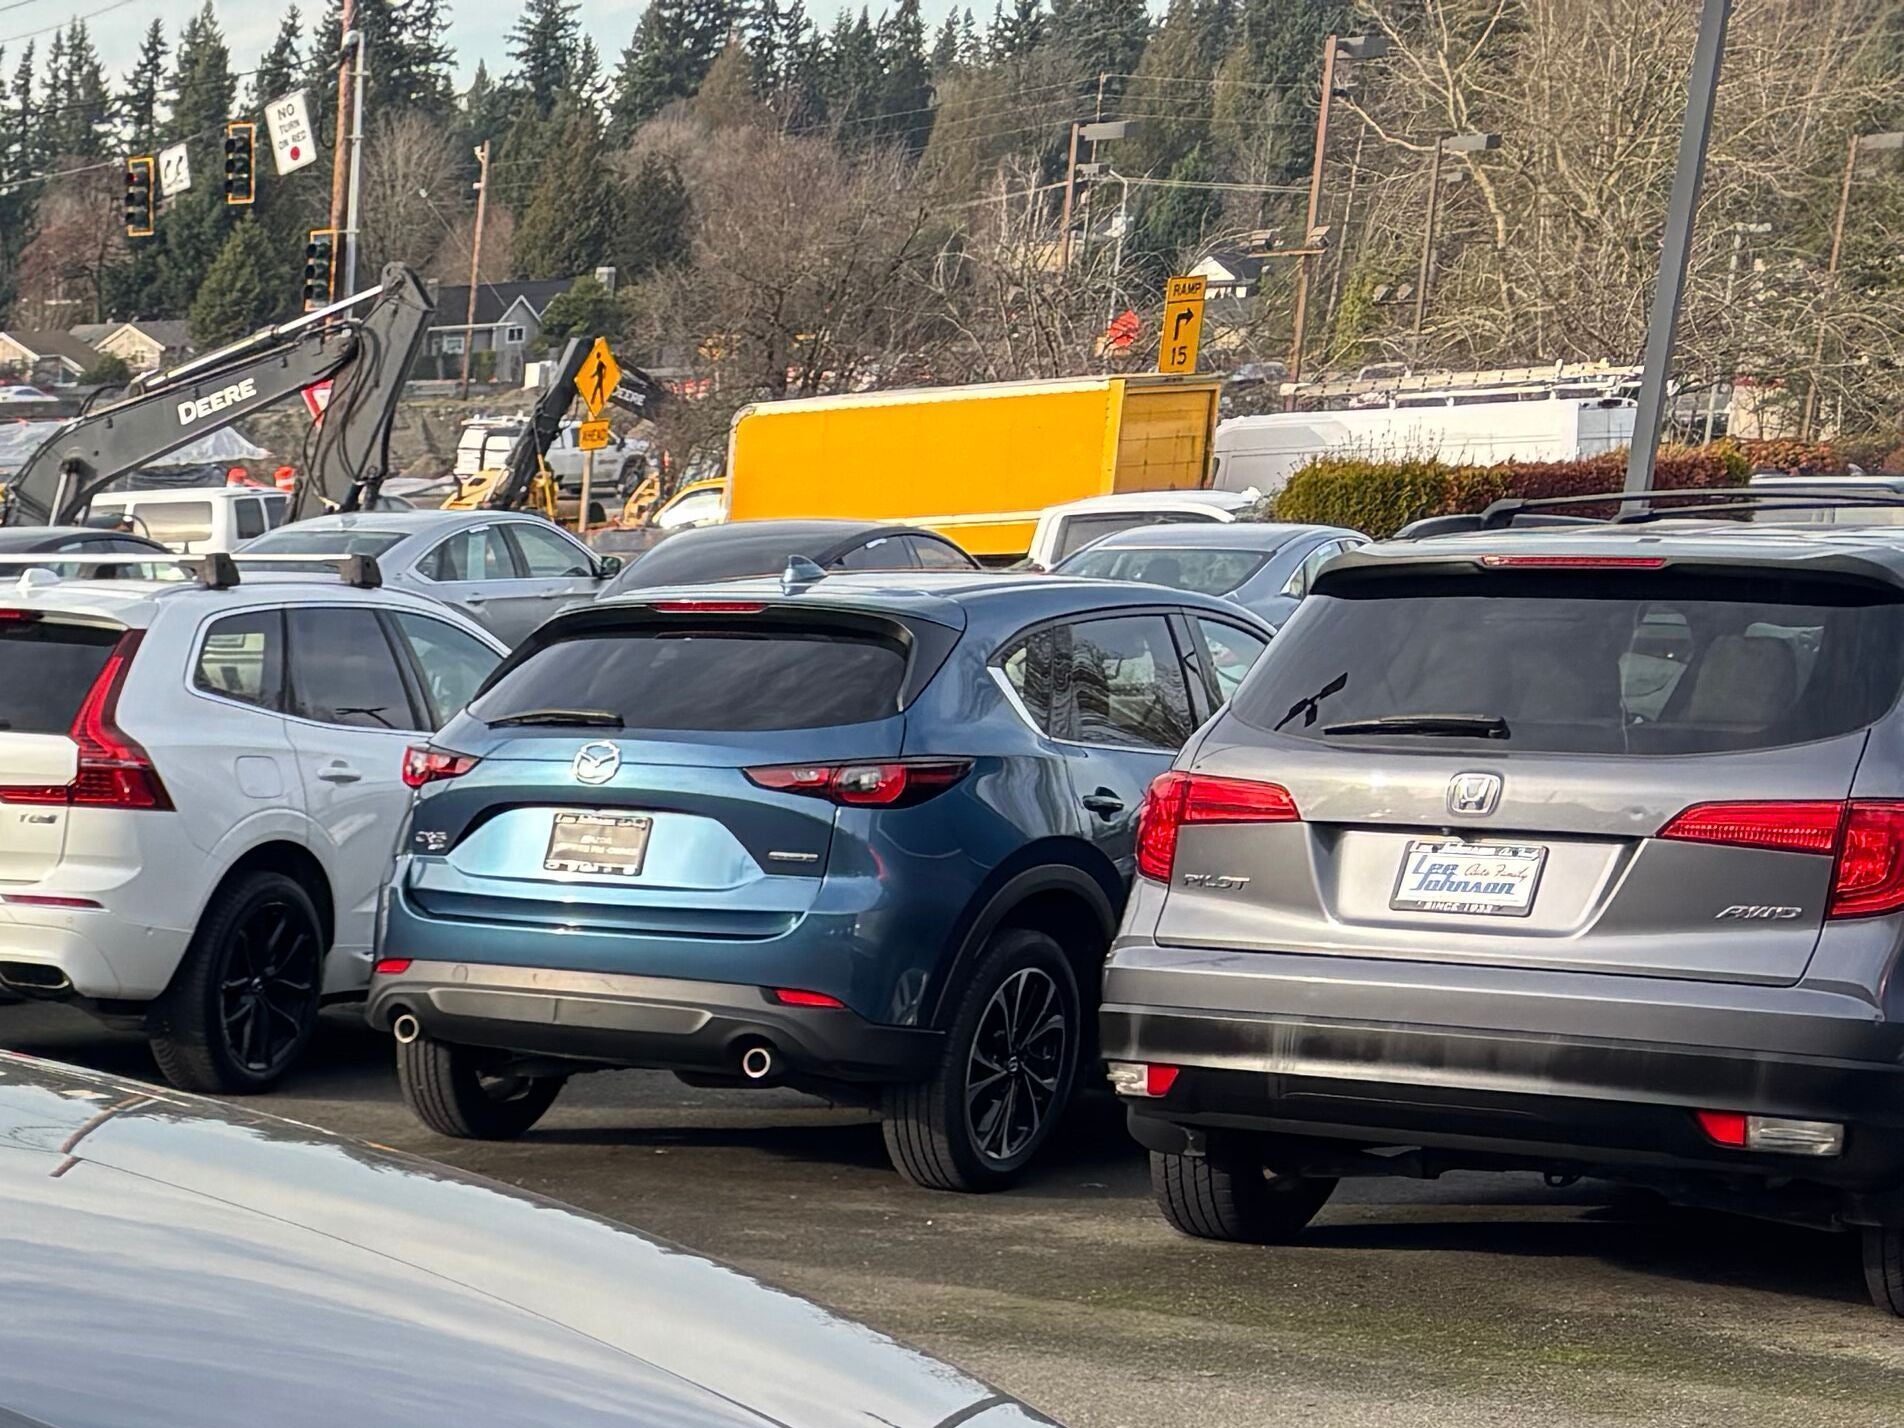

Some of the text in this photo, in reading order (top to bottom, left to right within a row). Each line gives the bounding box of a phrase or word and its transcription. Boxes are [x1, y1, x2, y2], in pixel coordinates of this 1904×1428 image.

[277, 103, 295, 120] NO
[1173, 282, 1201, 296] RAMP
[1171, 345, 1188, 365] 15
[177, 378, 257, 425] DEERE
[1411, 855, 1460, 876] Lee
[1184, 873, 1251, 890] PILOT
[1409, 872, 1515, 896] Johnson
[1713, 905, 1802, 920] AWD
